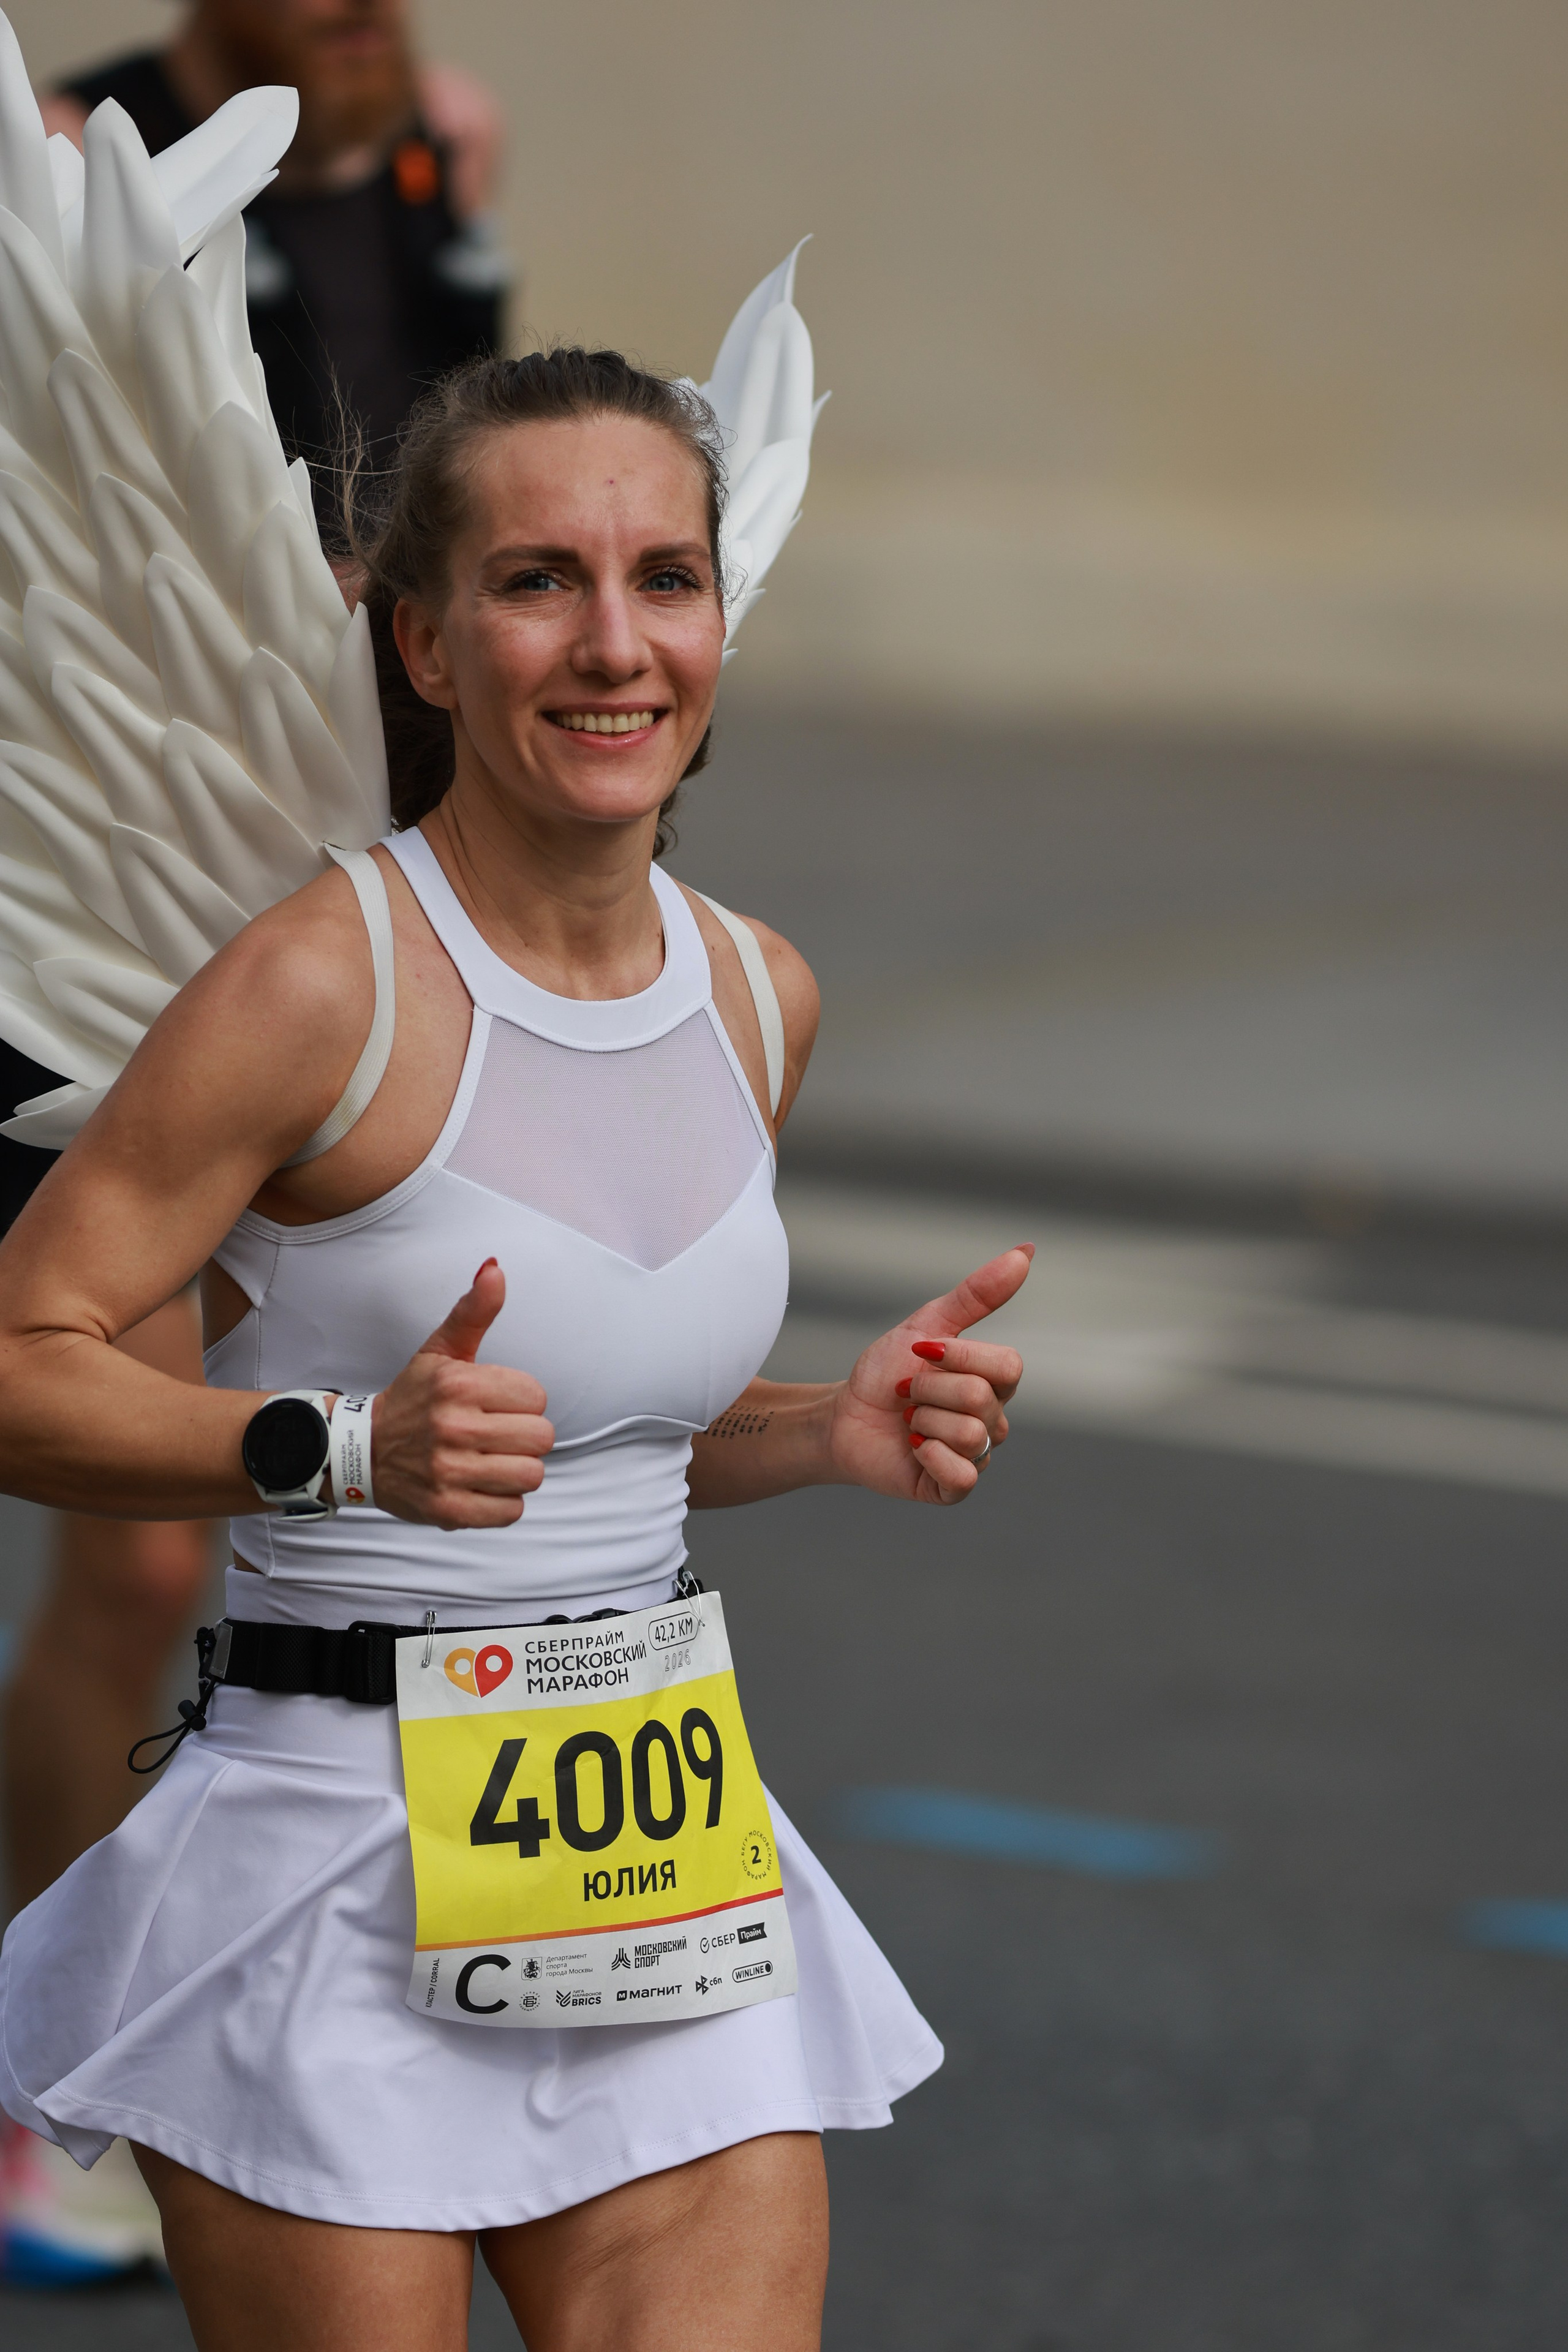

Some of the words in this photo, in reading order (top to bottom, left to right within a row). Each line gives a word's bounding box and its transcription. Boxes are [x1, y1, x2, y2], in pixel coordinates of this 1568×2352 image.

[344, 1394, 370, 1412] 40
[525, 1630, 624, 1654] СБЕРПРАЙМ
[655, 1622, 676, 1643] 42,2
[526, 1640, 647, 1674] МОСКОВСКИЙ
[665, 1649, 691, 1672] 2026
[527, 1667, 628, 1694] МАРАФОН
[470, 1708, 723, 1859] 4009
[750, 1845, 762, 1864] 2
[583, 1860, 677, 1901] ЮЛИЯ
[635, 1936, 687, 1957] МОСКОВСКИЙ
[711, 1933, 736, 1948] СБЕР
[741, 1928, 761, 1939] Прайм
[546, 1953, 587, 1963] Департамент
[635, 1955, 660, 1969] СПОРТ
[431, 1958, 440, 1983] CORRAL
[735, 1965, 764, 1980] WINLINE
[709, 1977, 722, 1986] сбп
[572, 1996, 601, 2007] BRICS
